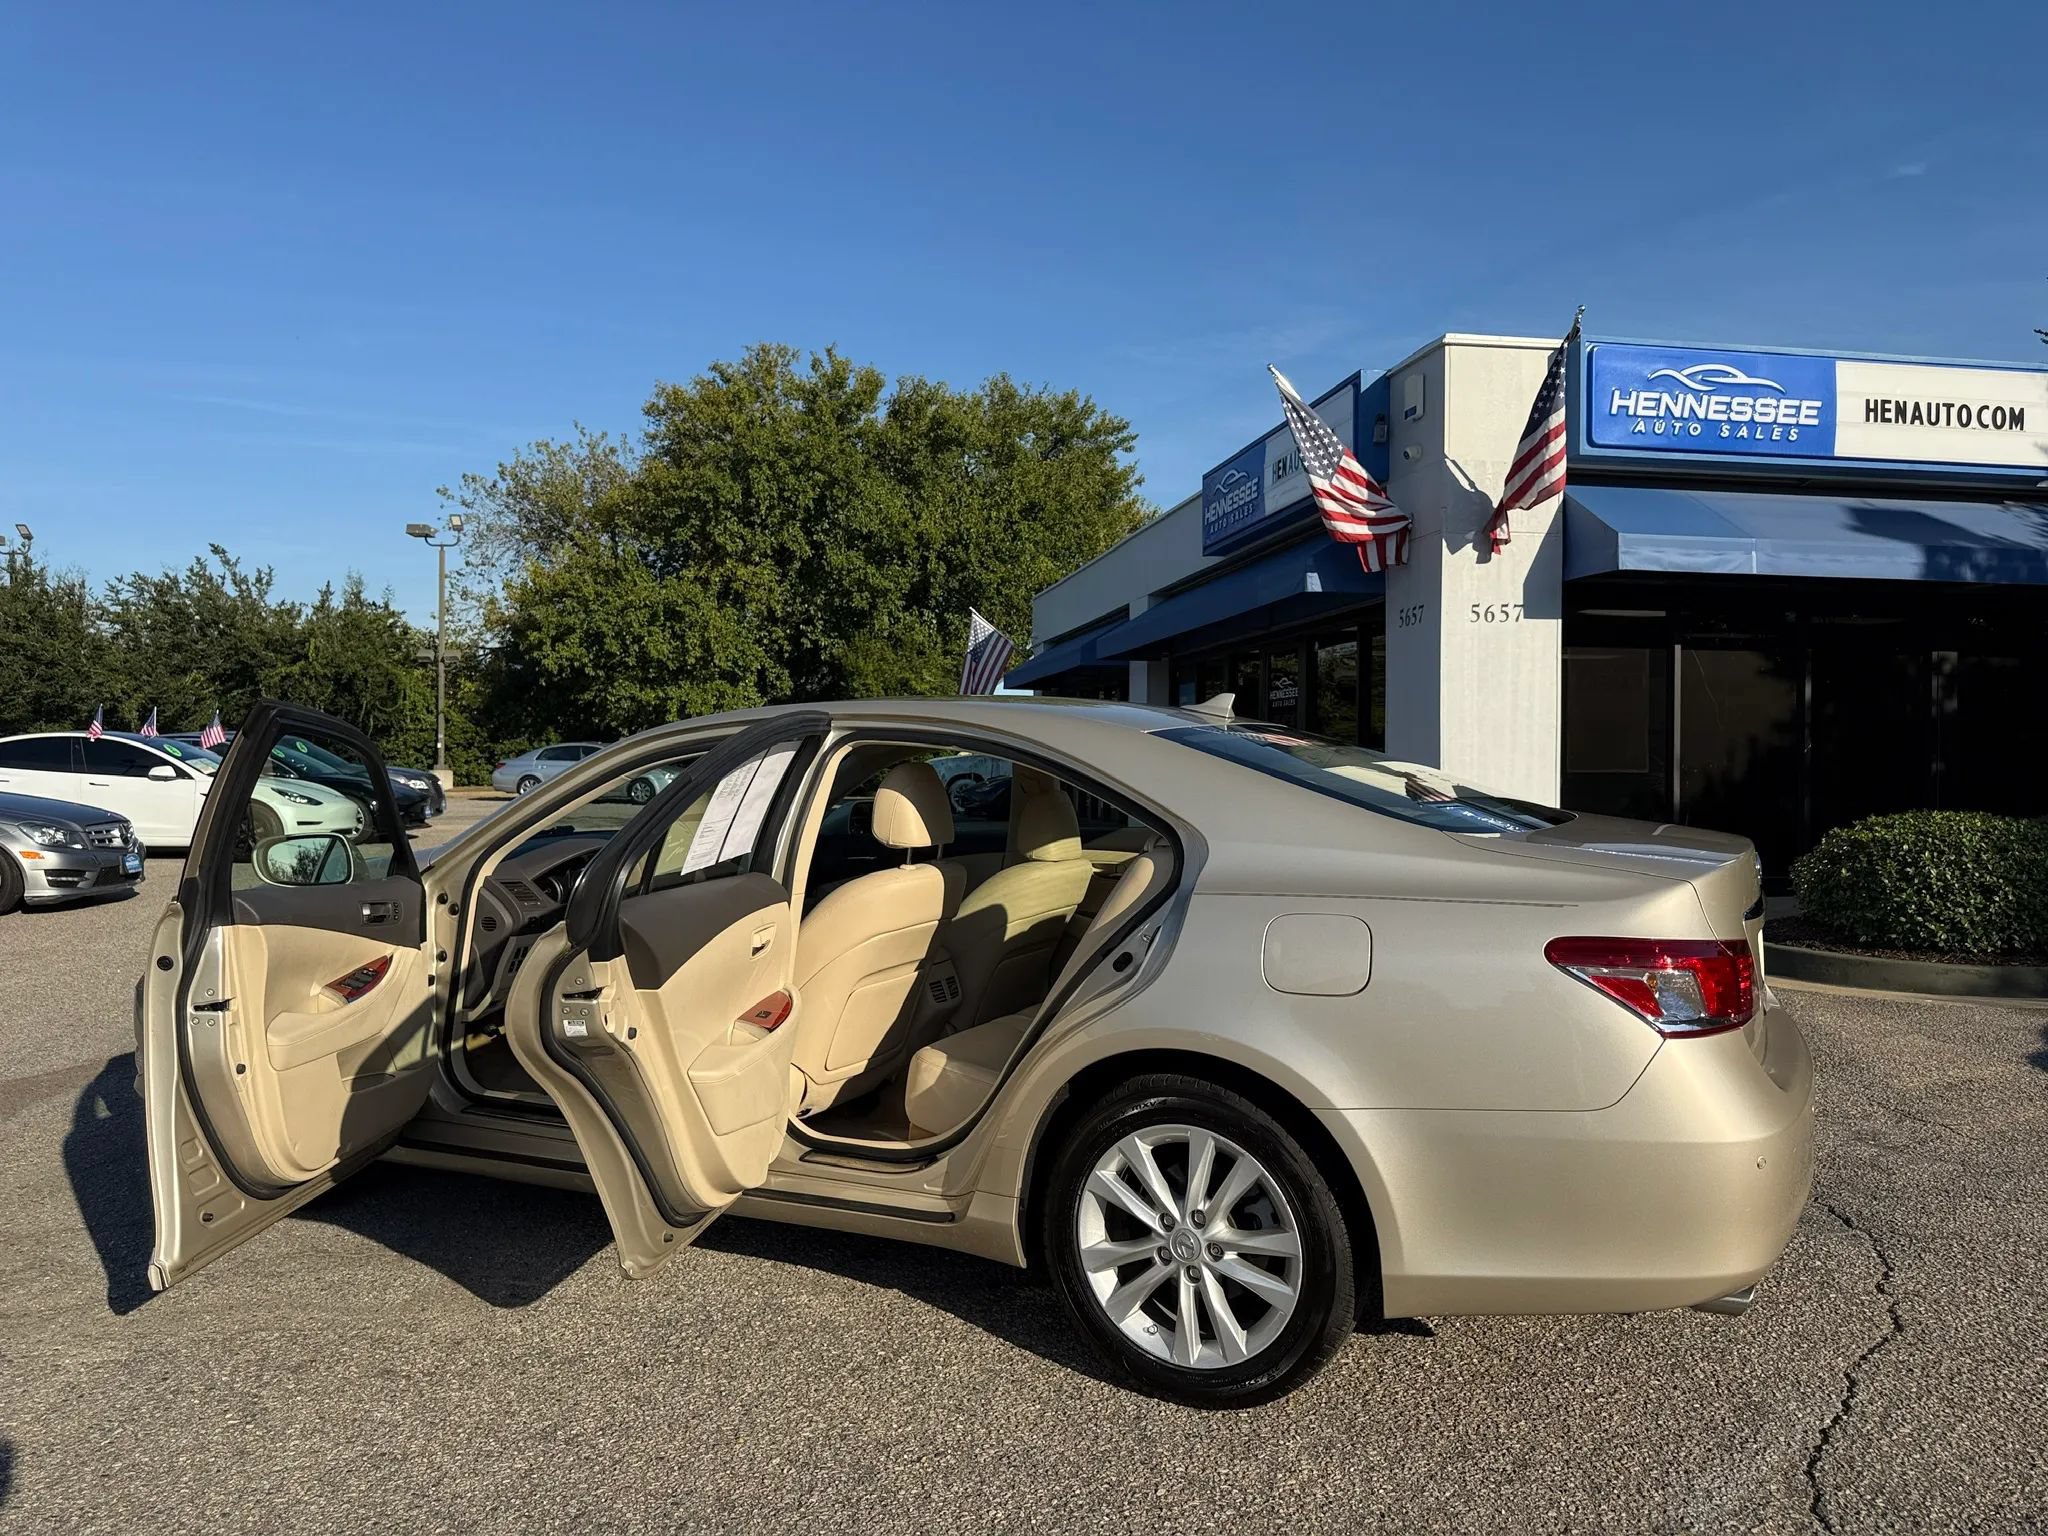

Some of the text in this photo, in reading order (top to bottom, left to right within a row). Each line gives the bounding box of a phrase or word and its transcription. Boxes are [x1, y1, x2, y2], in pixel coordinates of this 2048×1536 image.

[1610, 388, 1822, 426] HENNESSEE
[1633, 419, 1799, 441] AUTO SALES
[1204, 477, 1259, 525] HENNESSEE
[1210, 503, 1253, 534] AUTO SALES
[1399, 604, 1424, 628] 5657
[1470, 602, 1525, 622] 5657
